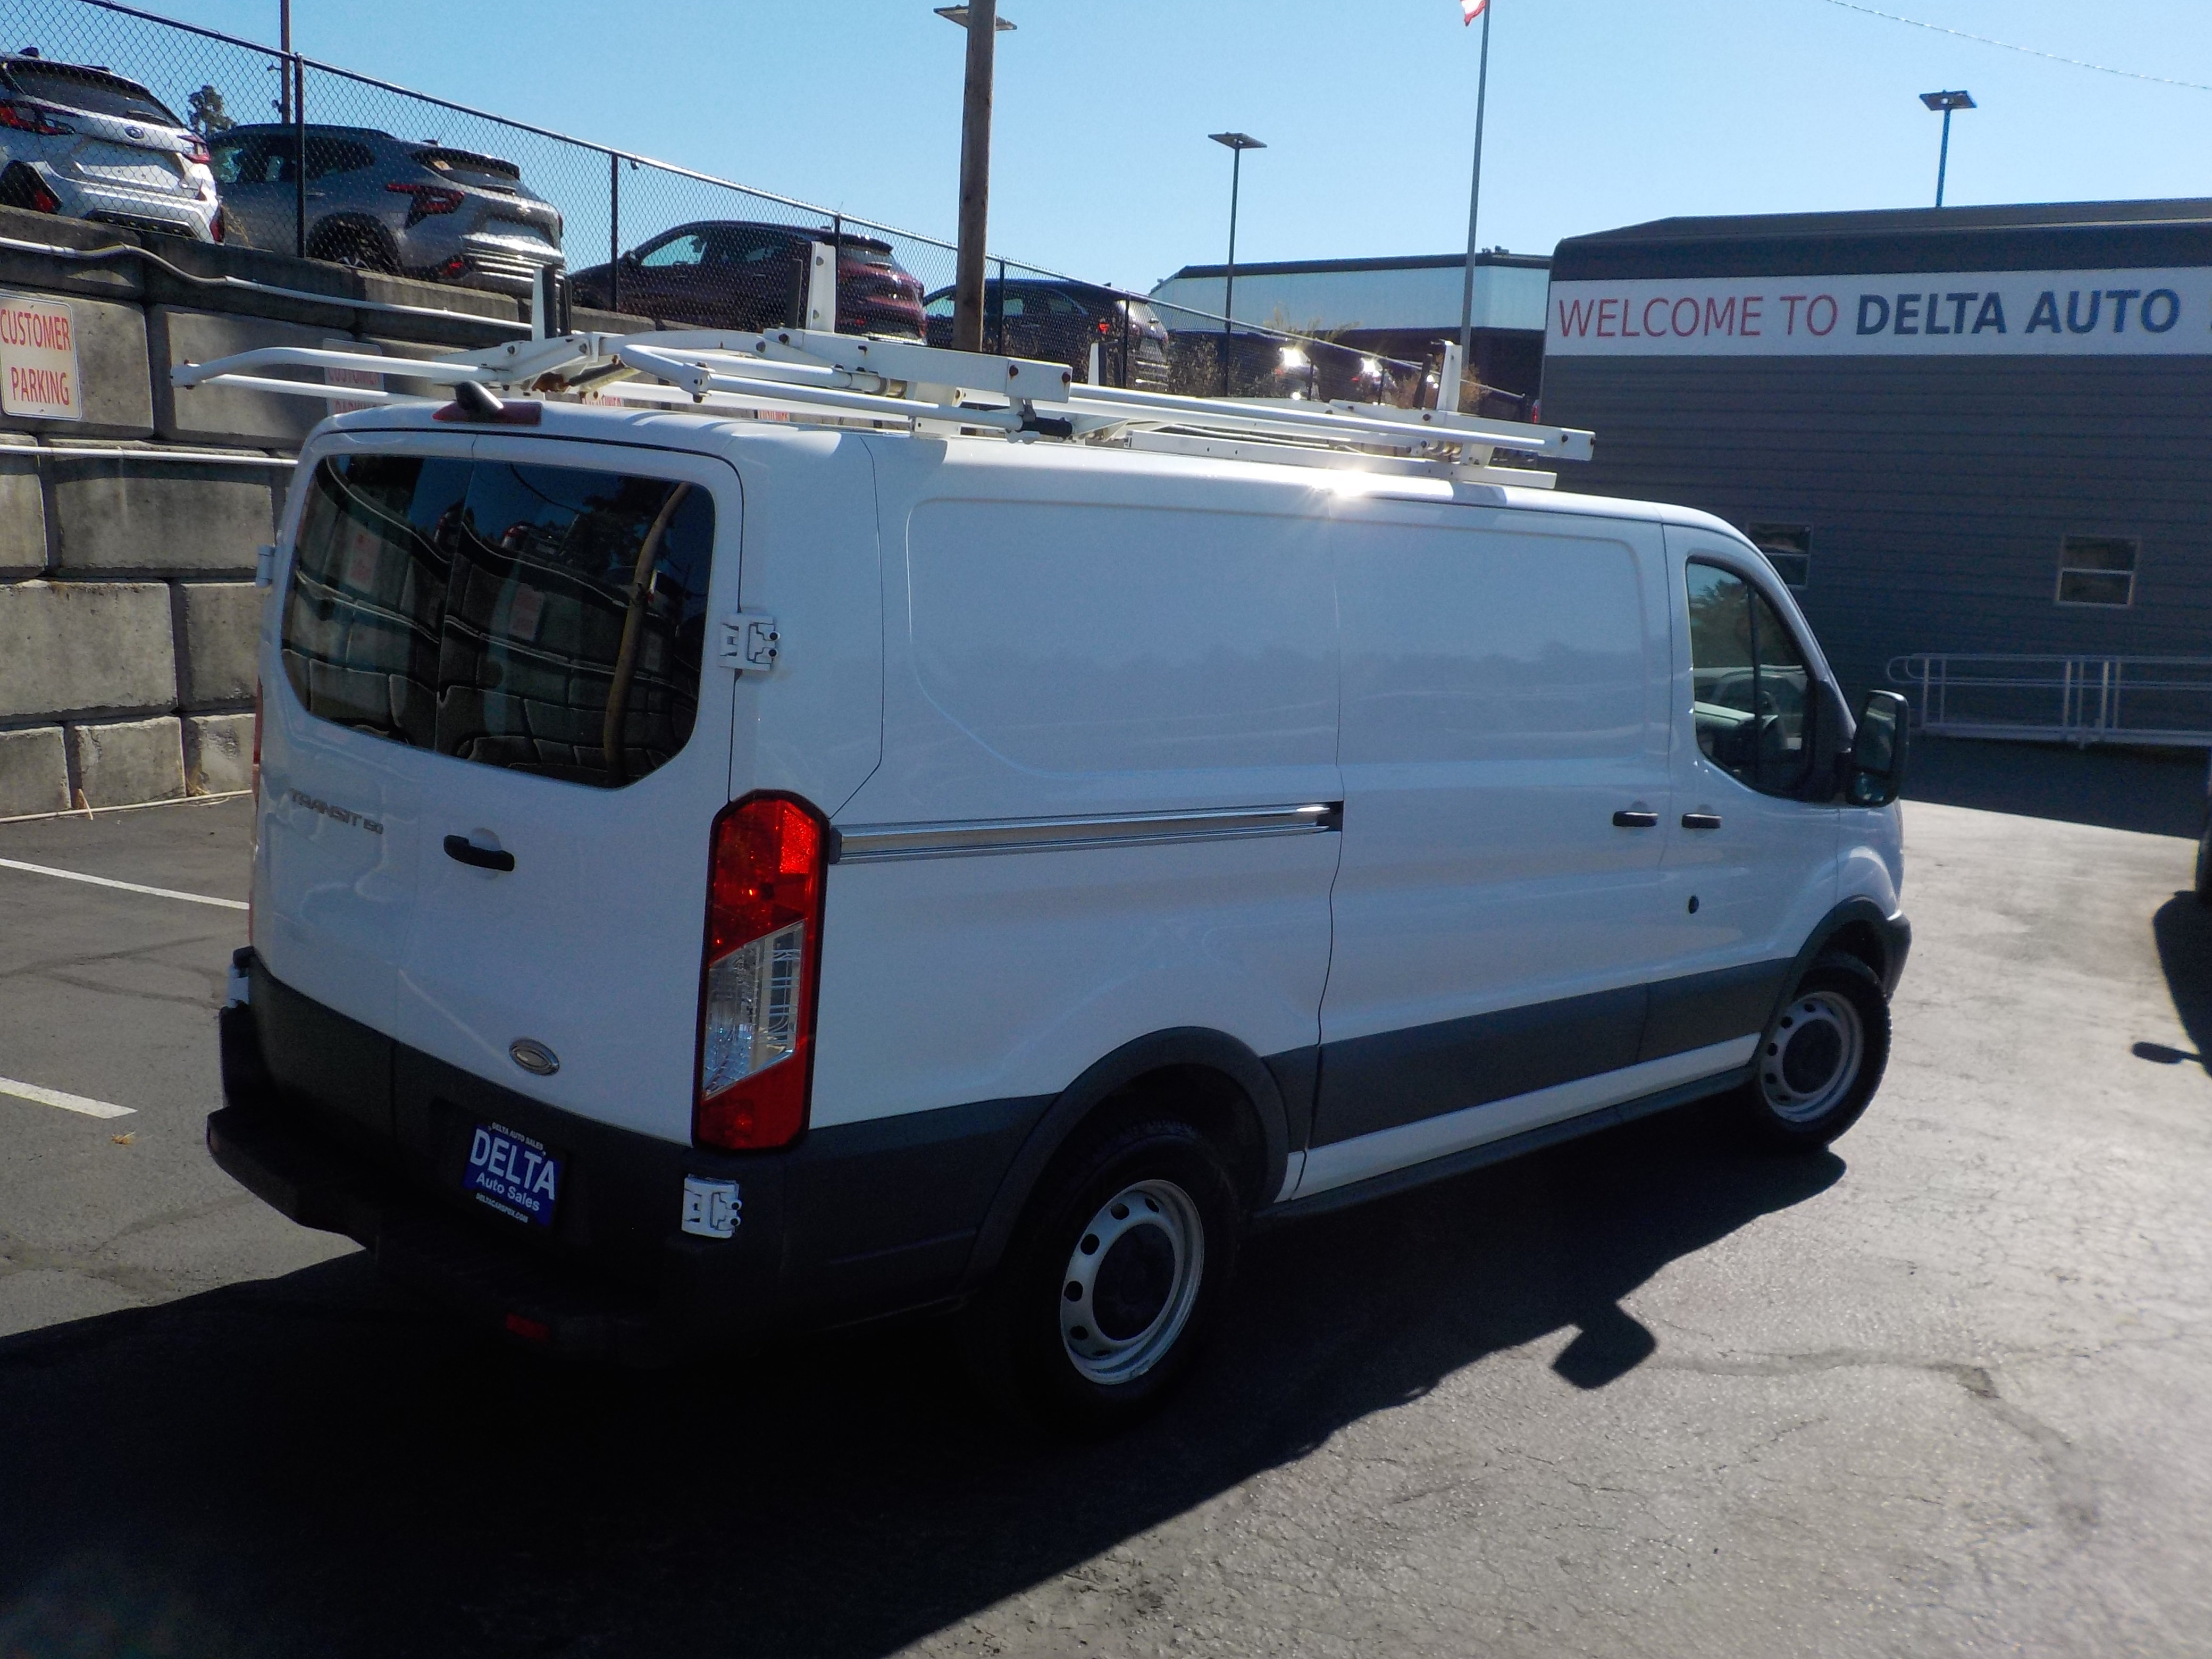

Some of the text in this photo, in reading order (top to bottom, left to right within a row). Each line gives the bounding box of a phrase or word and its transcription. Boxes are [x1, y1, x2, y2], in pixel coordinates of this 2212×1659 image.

[0, 308, 71, 351] CUSTOMER
[1559, 288, 2180, 337] WELCOME TO DELTA AUTO
[11, 366, 70, 406] PARKING
[491, 1121, 543, 1151] DELTA AUTO SALES
[470, 1128, 555, 1201] DELTA
[475, 1172, 540, 1211] Auto Sales
